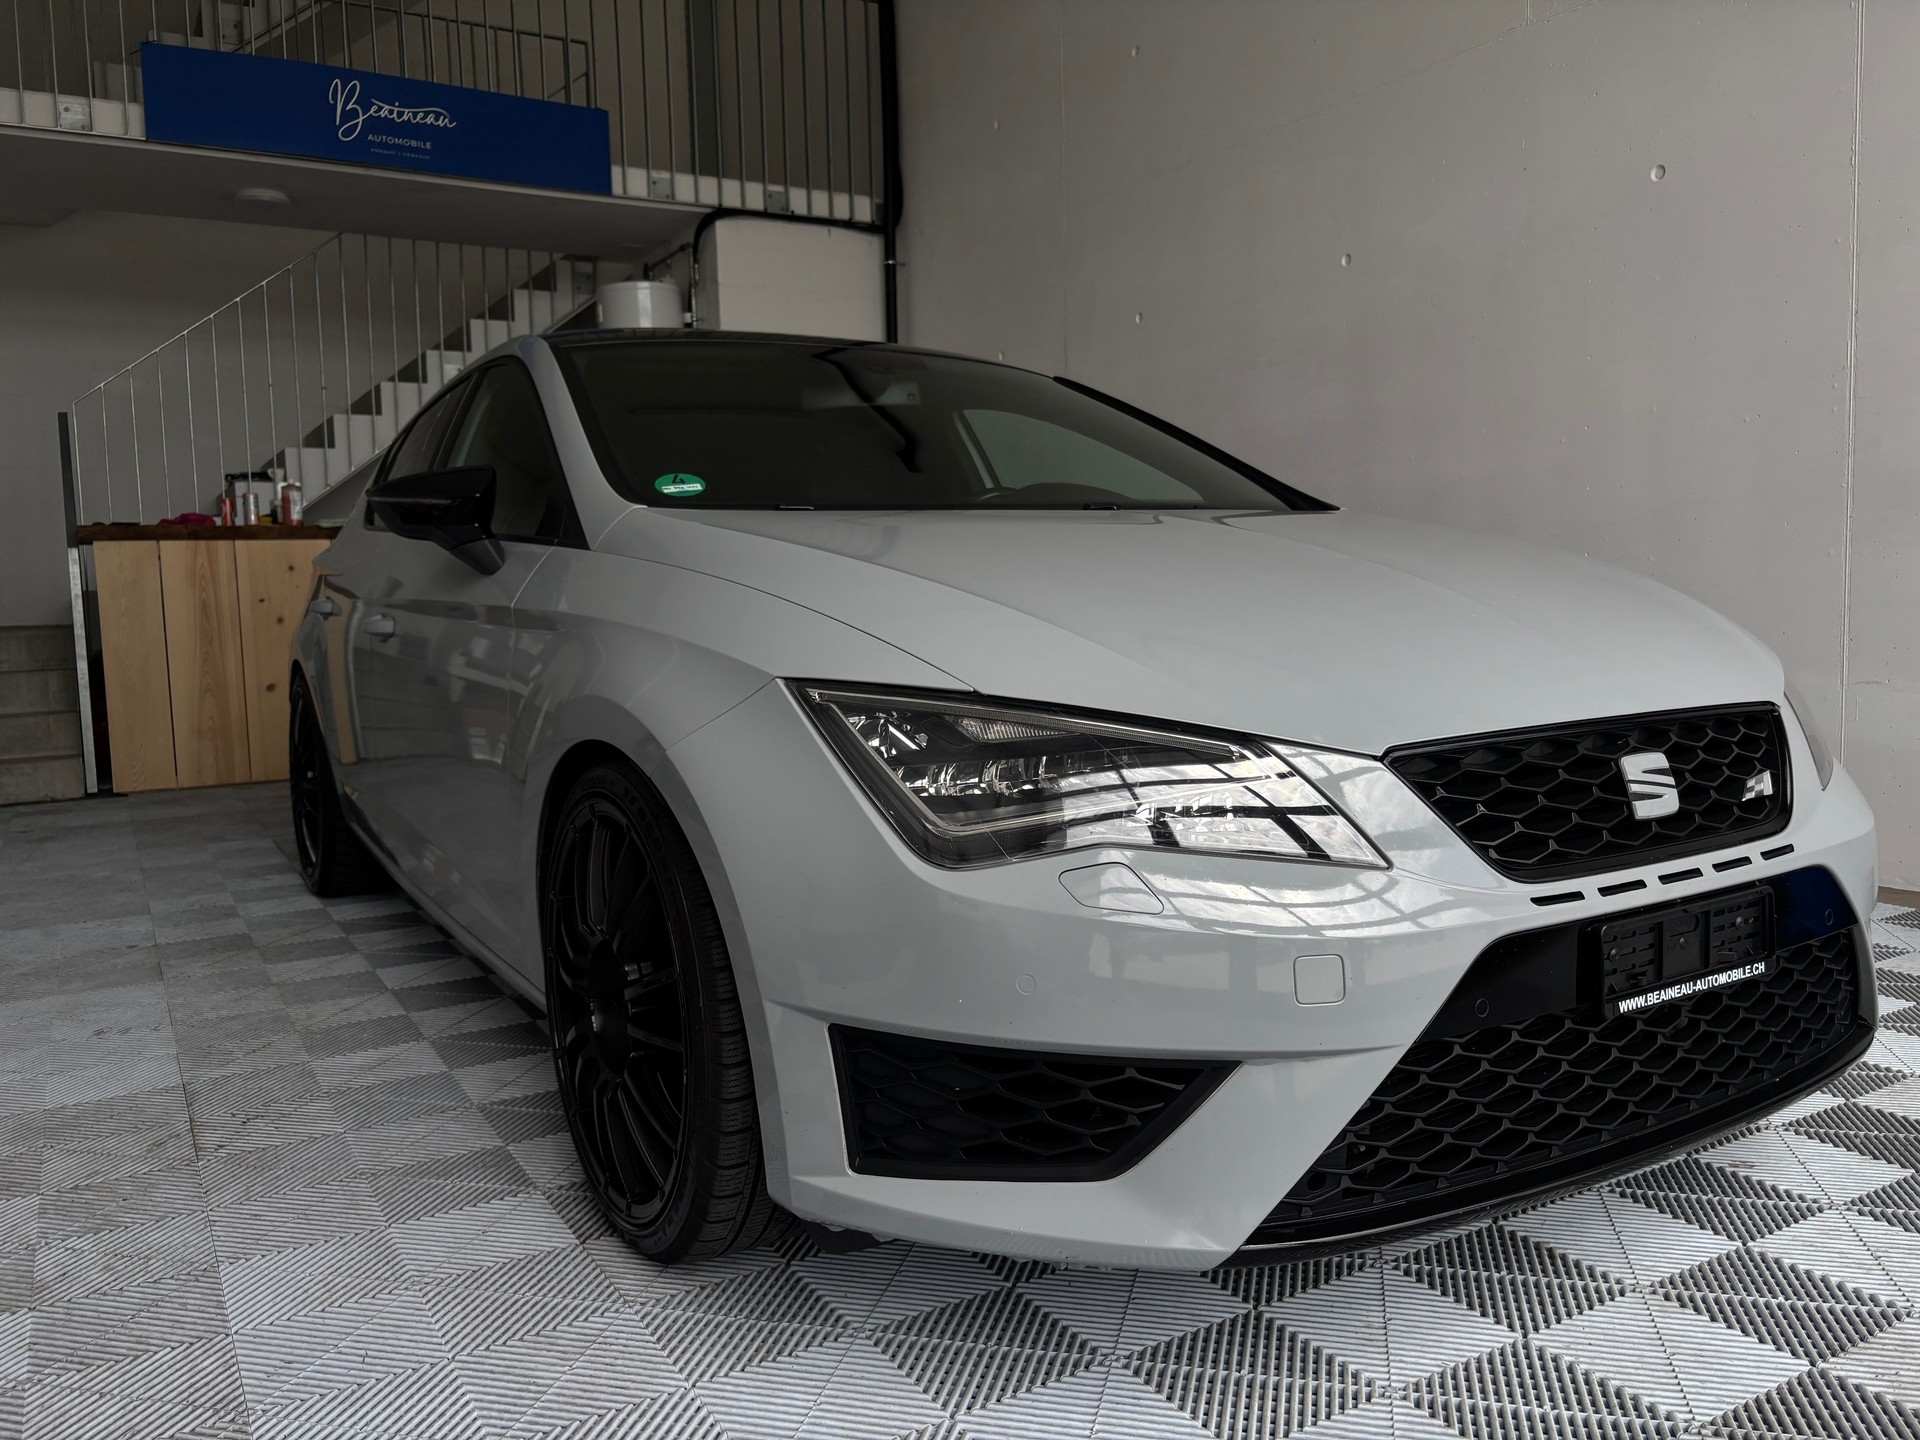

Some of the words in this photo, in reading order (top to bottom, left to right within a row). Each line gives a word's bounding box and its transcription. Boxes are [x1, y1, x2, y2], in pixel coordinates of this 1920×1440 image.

[329, 79, 456, 141] Beaineau
[367, 134, 432, 150] AUTOMOBILE
[1618, 961, 1765, 1013] WWW.BEAINEAU-AUTOMOBILE.CH
